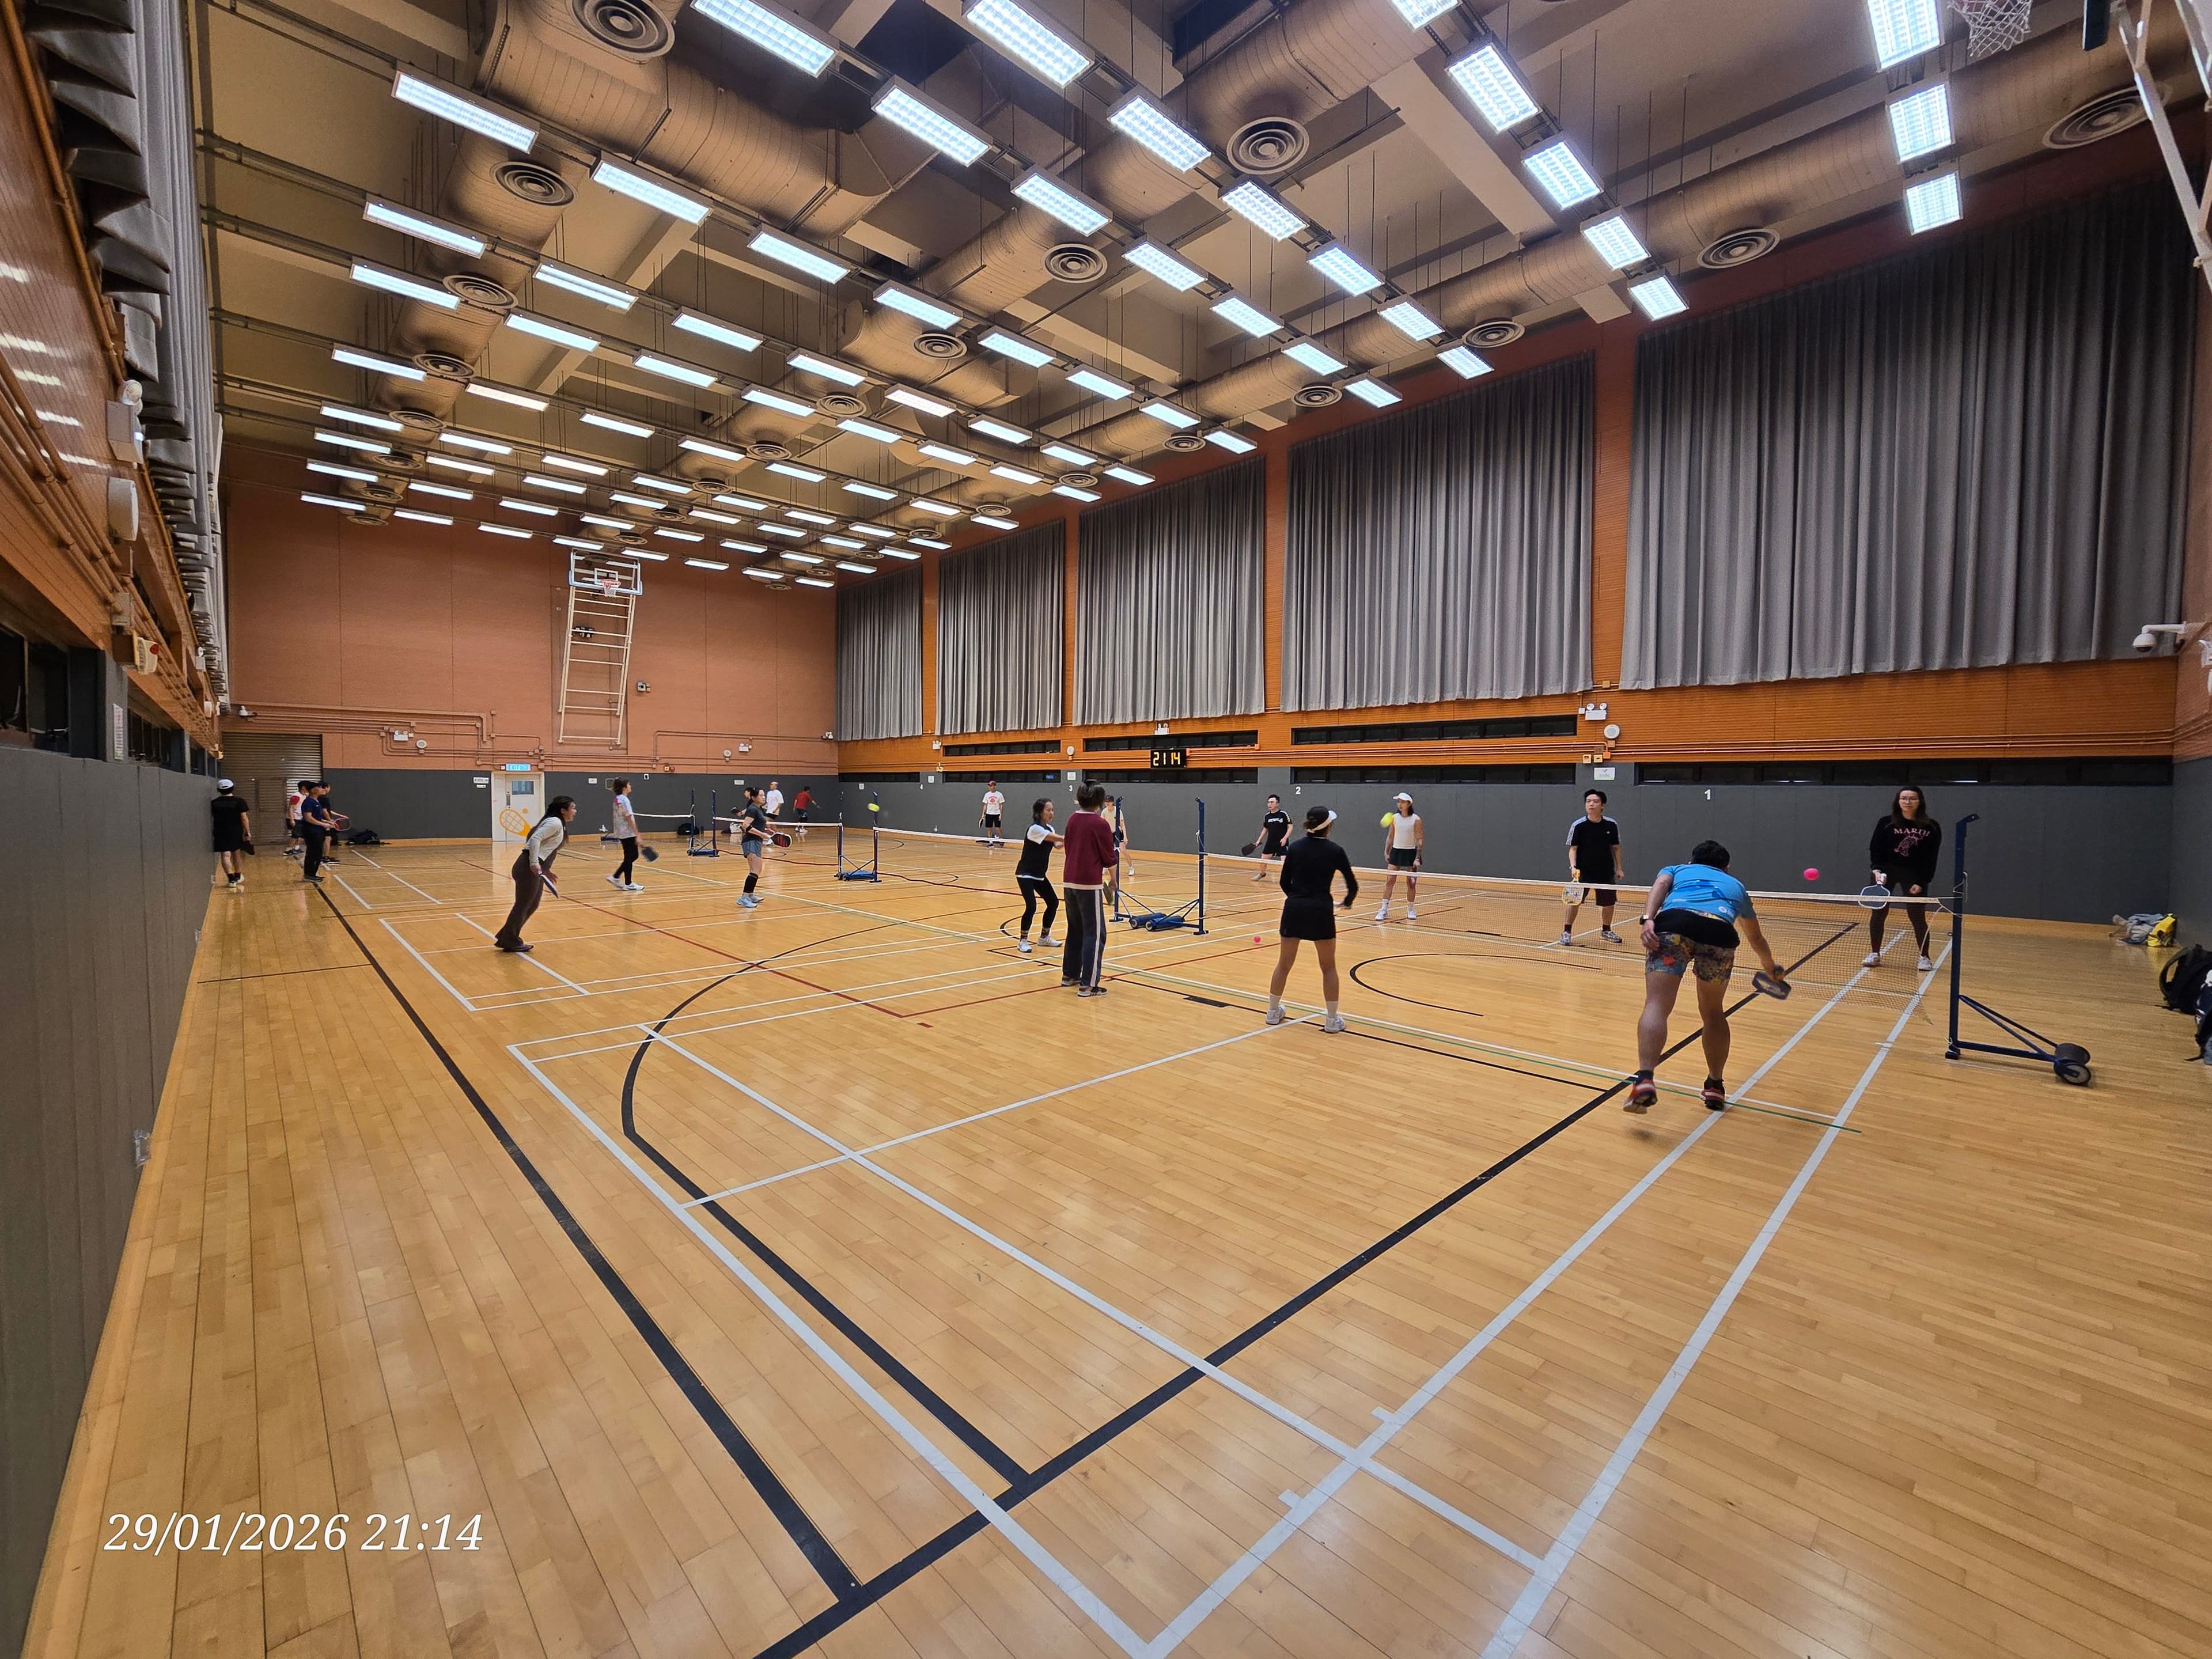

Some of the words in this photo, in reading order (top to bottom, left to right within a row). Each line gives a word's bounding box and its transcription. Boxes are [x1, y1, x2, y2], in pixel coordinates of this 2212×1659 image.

[1295, 786, 1301, 794] 2
[1705, 789, 1710, 800] 1
[1894, 828, 1930, 836] MARDI
